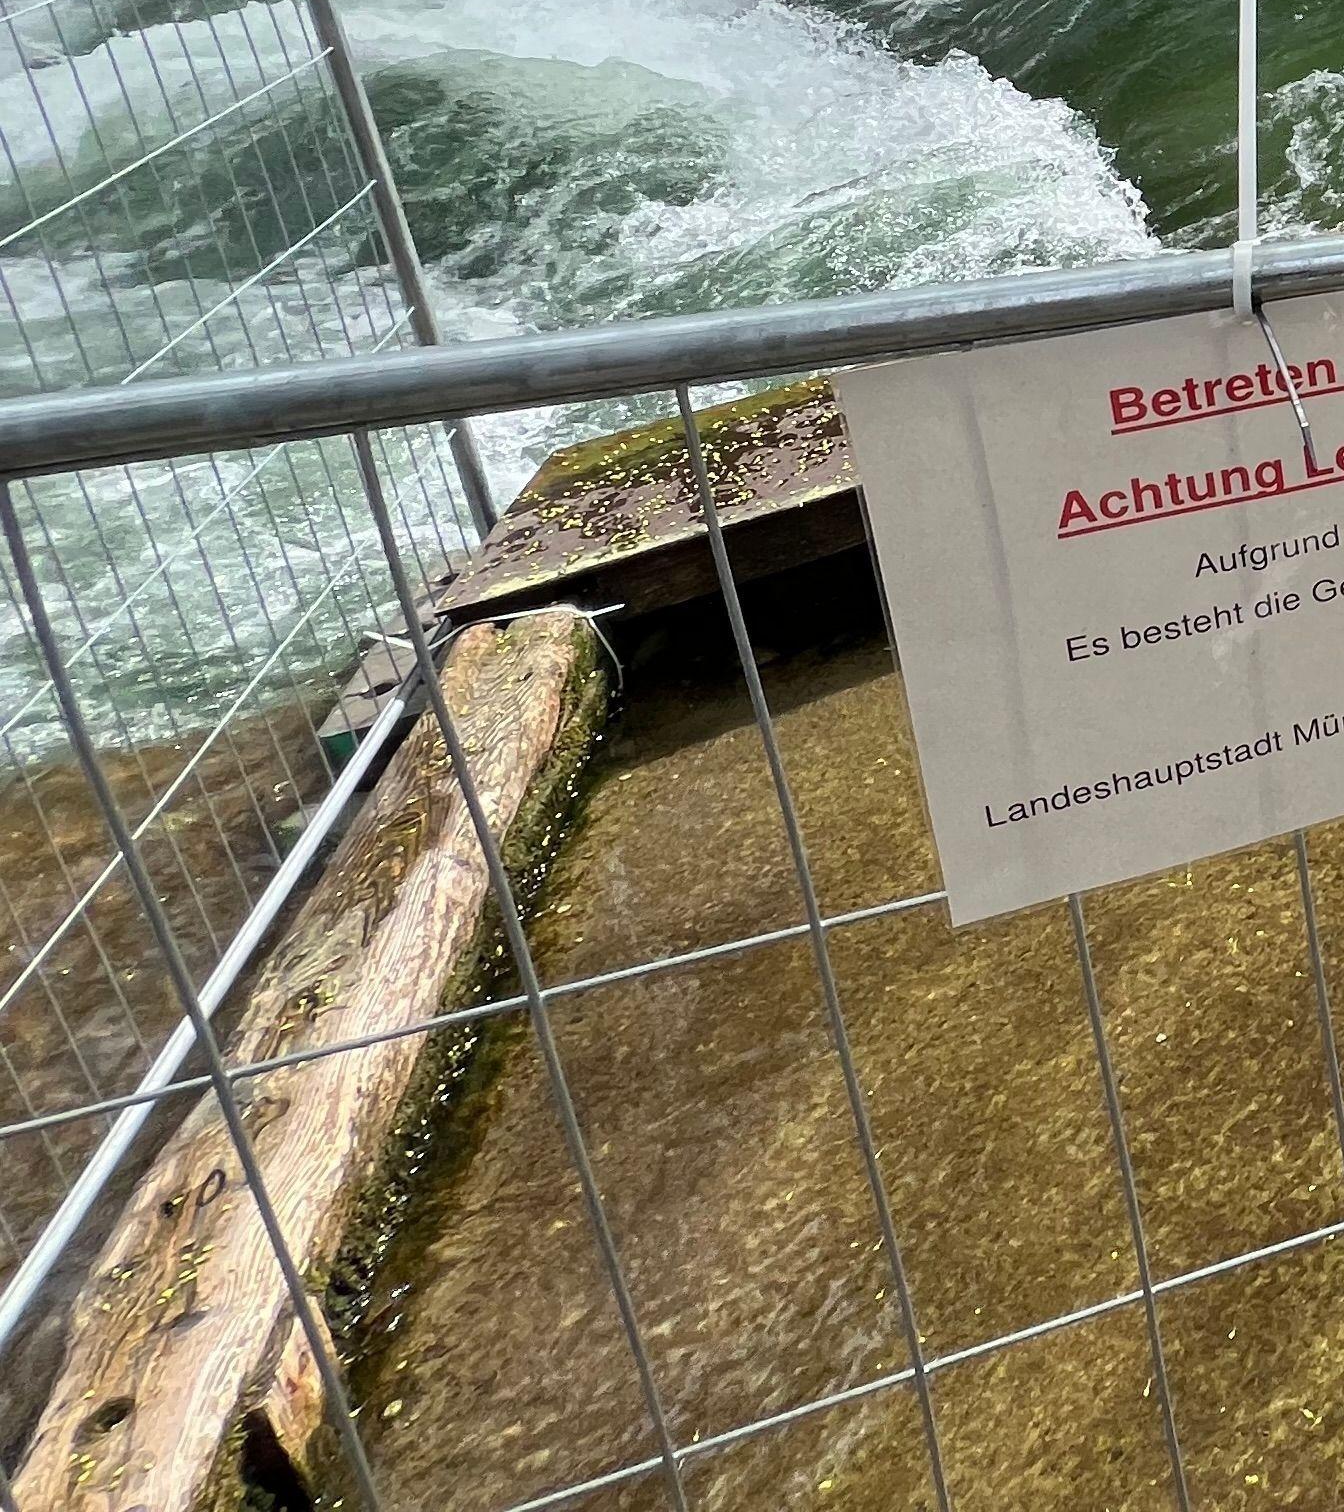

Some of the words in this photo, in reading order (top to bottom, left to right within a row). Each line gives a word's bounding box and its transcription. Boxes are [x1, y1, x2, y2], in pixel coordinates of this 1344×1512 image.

[1108, 357, 1336, 426] Betreten
[1057, 452, 1285, 529] Achtung
[1194, 523, 1341, 579] Aufgrund
[1065, 634, 1111, 662] Es
[1120, 601, 1245, 650] besteht
[1253, 590, 1301, 619] die
[985, 730, 1283, 828] Landeshauptstadt
